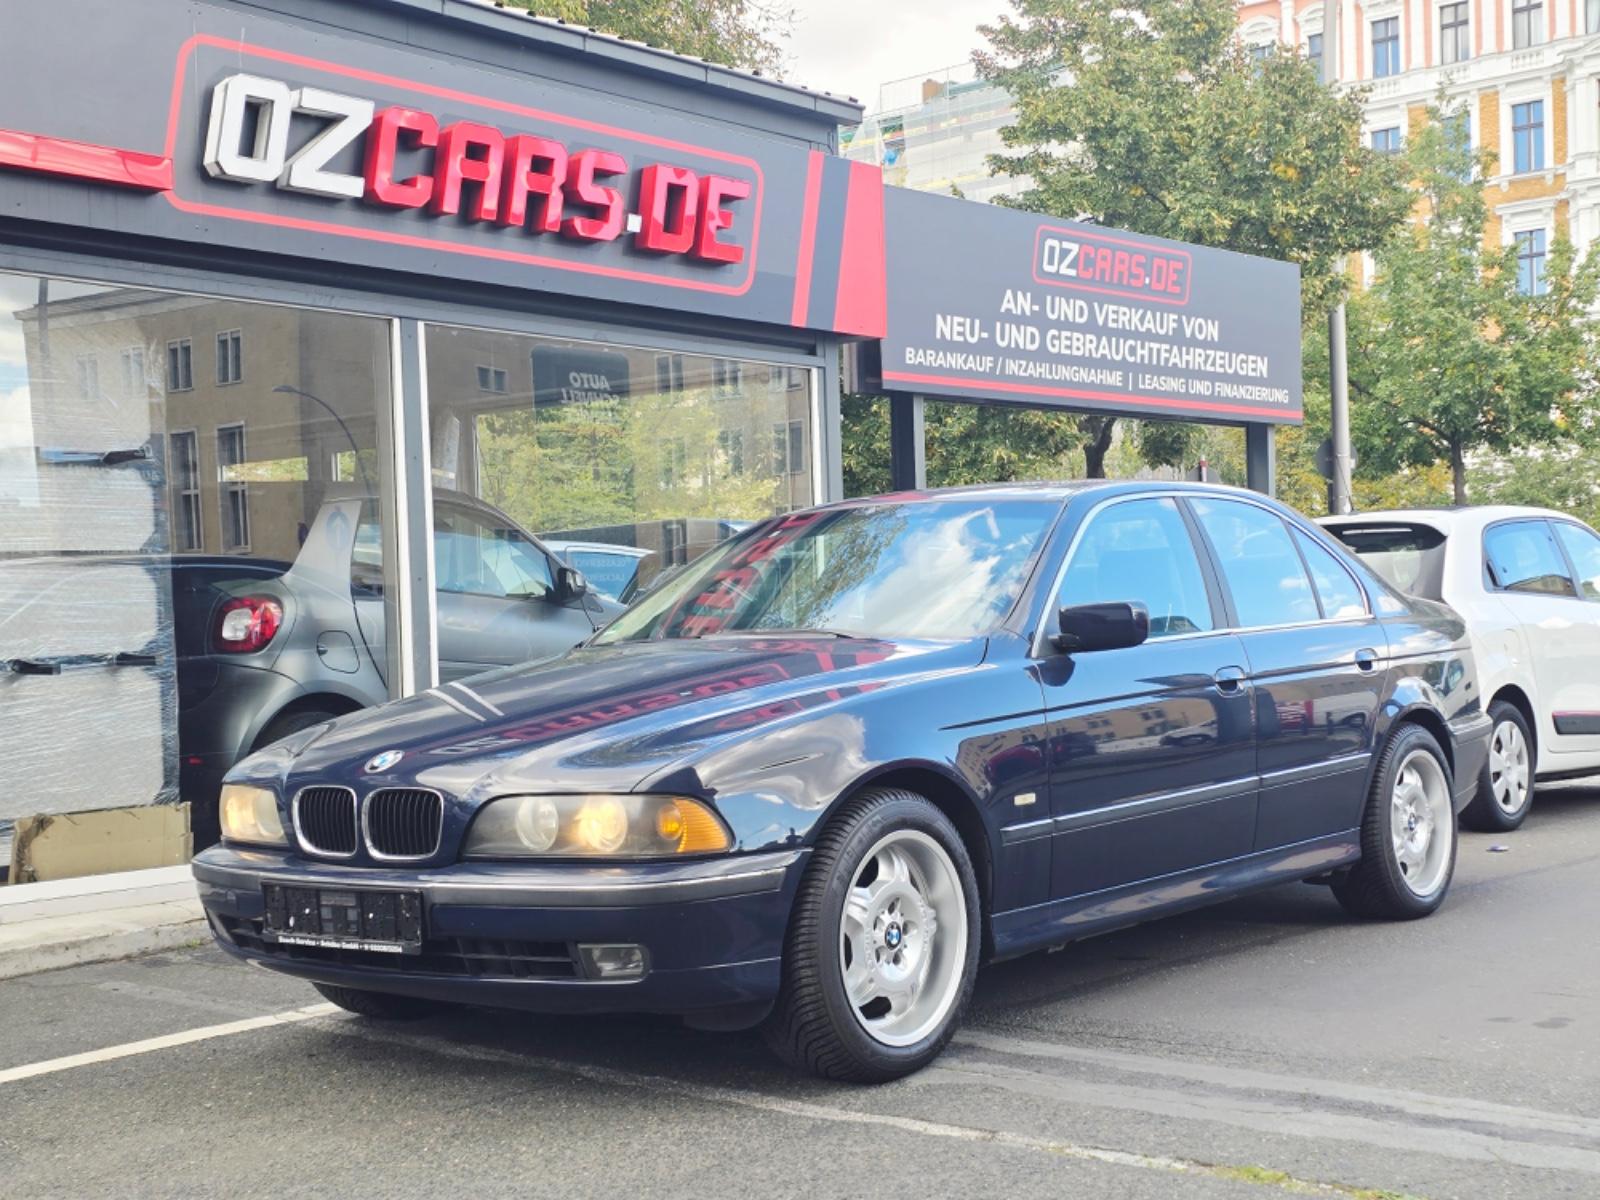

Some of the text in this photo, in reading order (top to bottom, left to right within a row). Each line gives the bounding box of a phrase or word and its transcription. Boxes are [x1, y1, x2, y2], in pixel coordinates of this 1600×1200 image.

[203, 73, 751, 265] OZCARS.DE
[1042, 238, 1184, 294] OZCARS.DE
[1000, 289, 1219, 342] AN- UND VERKAUF VON
[935, 313, 1268, 378] NEU- UND GEBRAUCHTFAHRZEUGEN
[905, 347, 994, 372] BARANKAUF
[1005, 359, 1123, 386] INZAHLUNGNAHME
[1138, 374, 1186, 394] LEASING
[1188, 379, 1212, 396] UND
[1214, 382, 1289, 404] FINANZIERUNG
